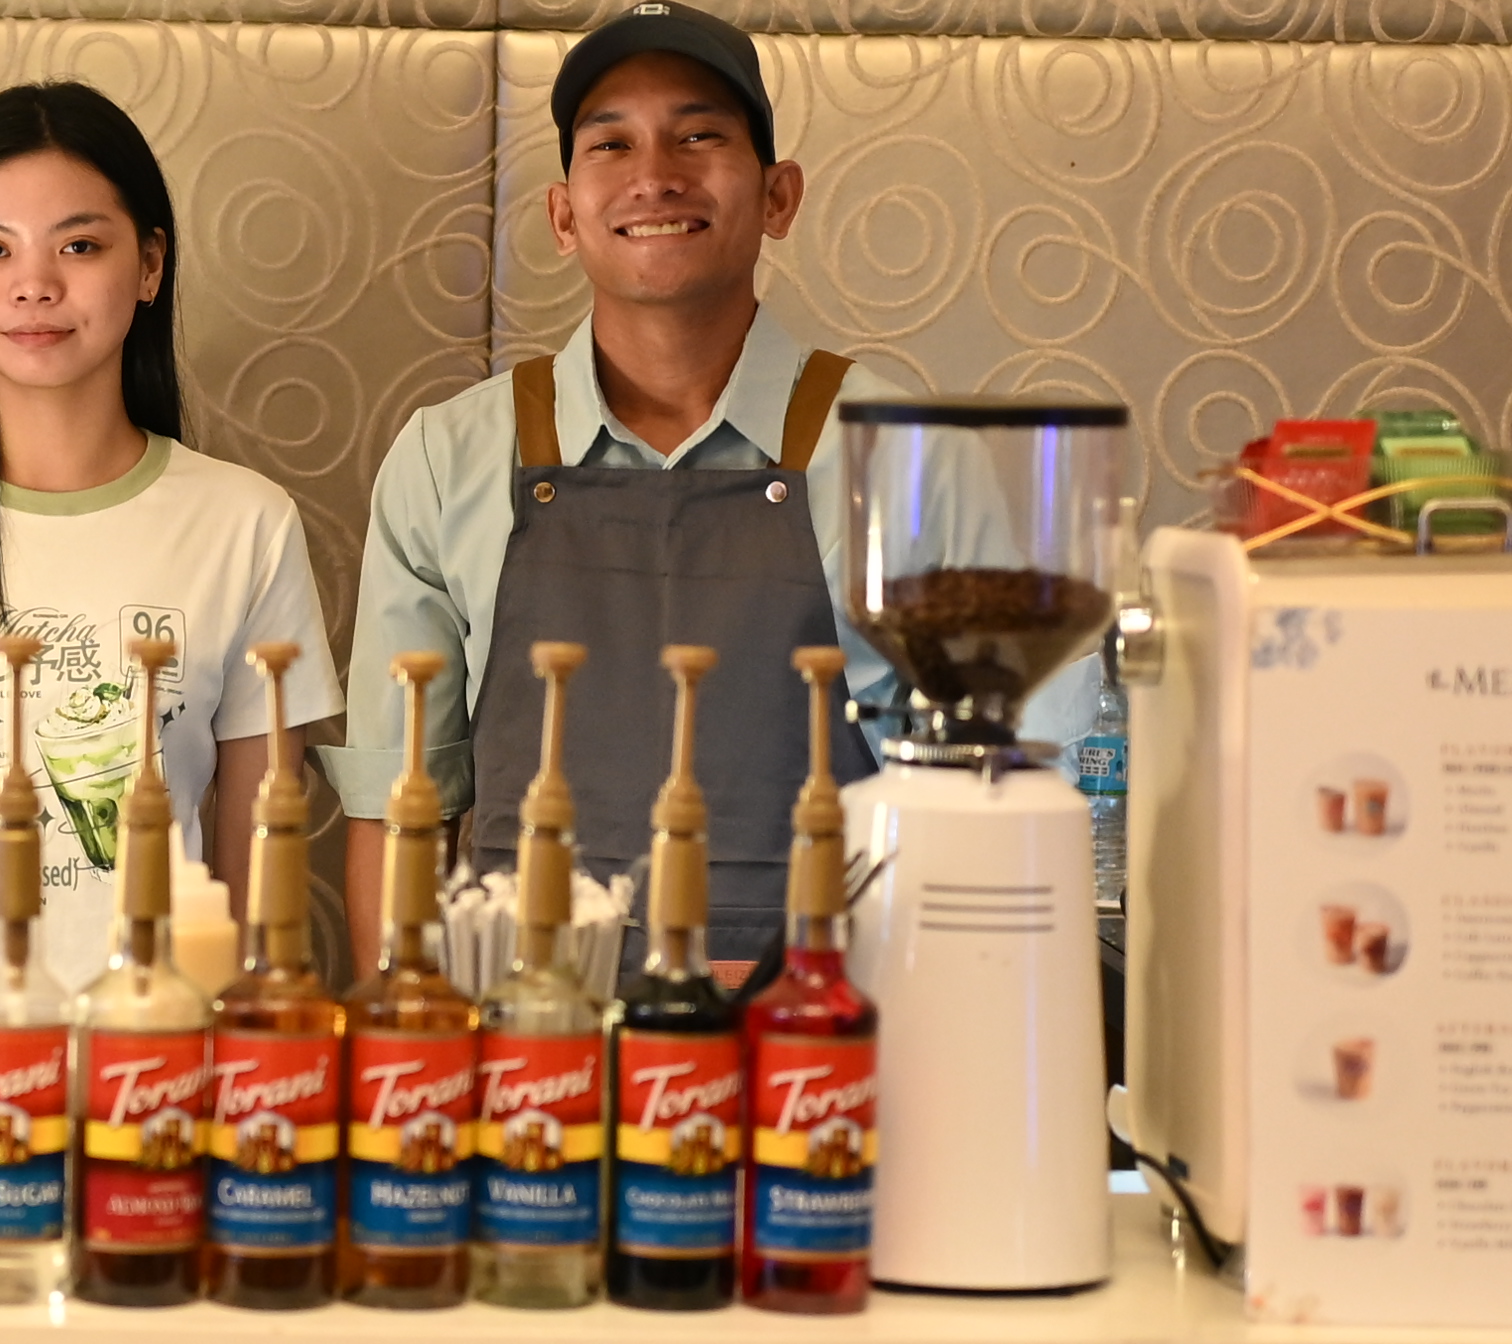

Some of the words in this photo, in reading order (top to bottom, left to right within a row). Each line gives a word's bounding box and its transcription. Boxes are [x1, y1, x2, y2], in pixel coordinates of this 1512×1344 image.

[20, 690, 42, 699] OVE
[100, 1056, 213, 1128] Toran
[213, 1053, 330, 1126] Torani
[360, 1058, 475, 1129] Toran
[478, 1054, 597, 1124] Torani
[631, 1060, 743, 1132] Toran
[768, 1064, 876, 1135] Toran
